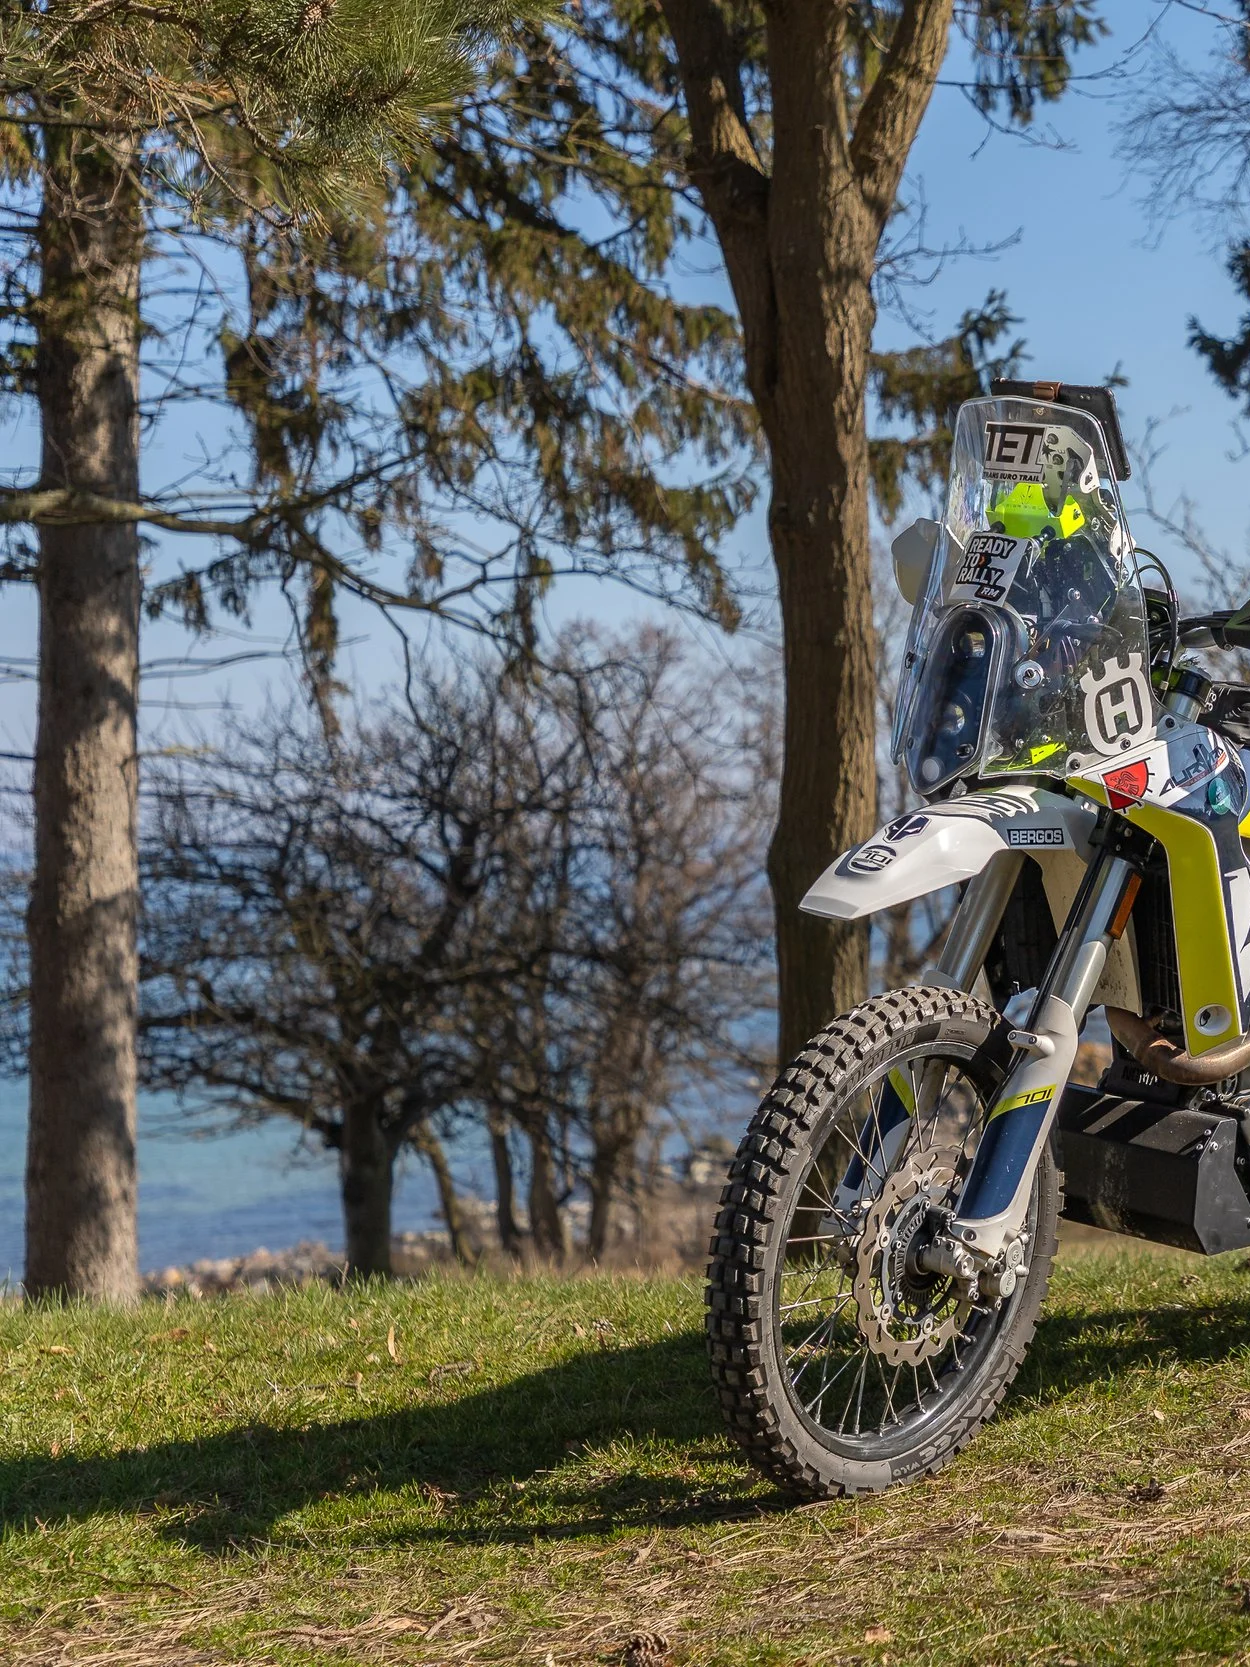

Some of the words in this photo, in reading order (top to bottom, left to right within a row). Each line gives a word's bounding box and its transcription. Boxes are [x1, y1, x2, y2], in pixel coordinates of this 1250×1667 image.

[983, 471, 999, 480] TRANS
[1000, 473, 1017, 481] EURO
[1019, 474, 1040, 482] TRAIL
[969, 538, 1014, 557] READY
[965, 552, 981, 568] TO
[957, 567, 1002, 586] RALLY
[981, 587, 1000, 598] RM
[1009, 829, 1063, 845] BERGOS
[1016, 1088, 1052, 1105] 701
